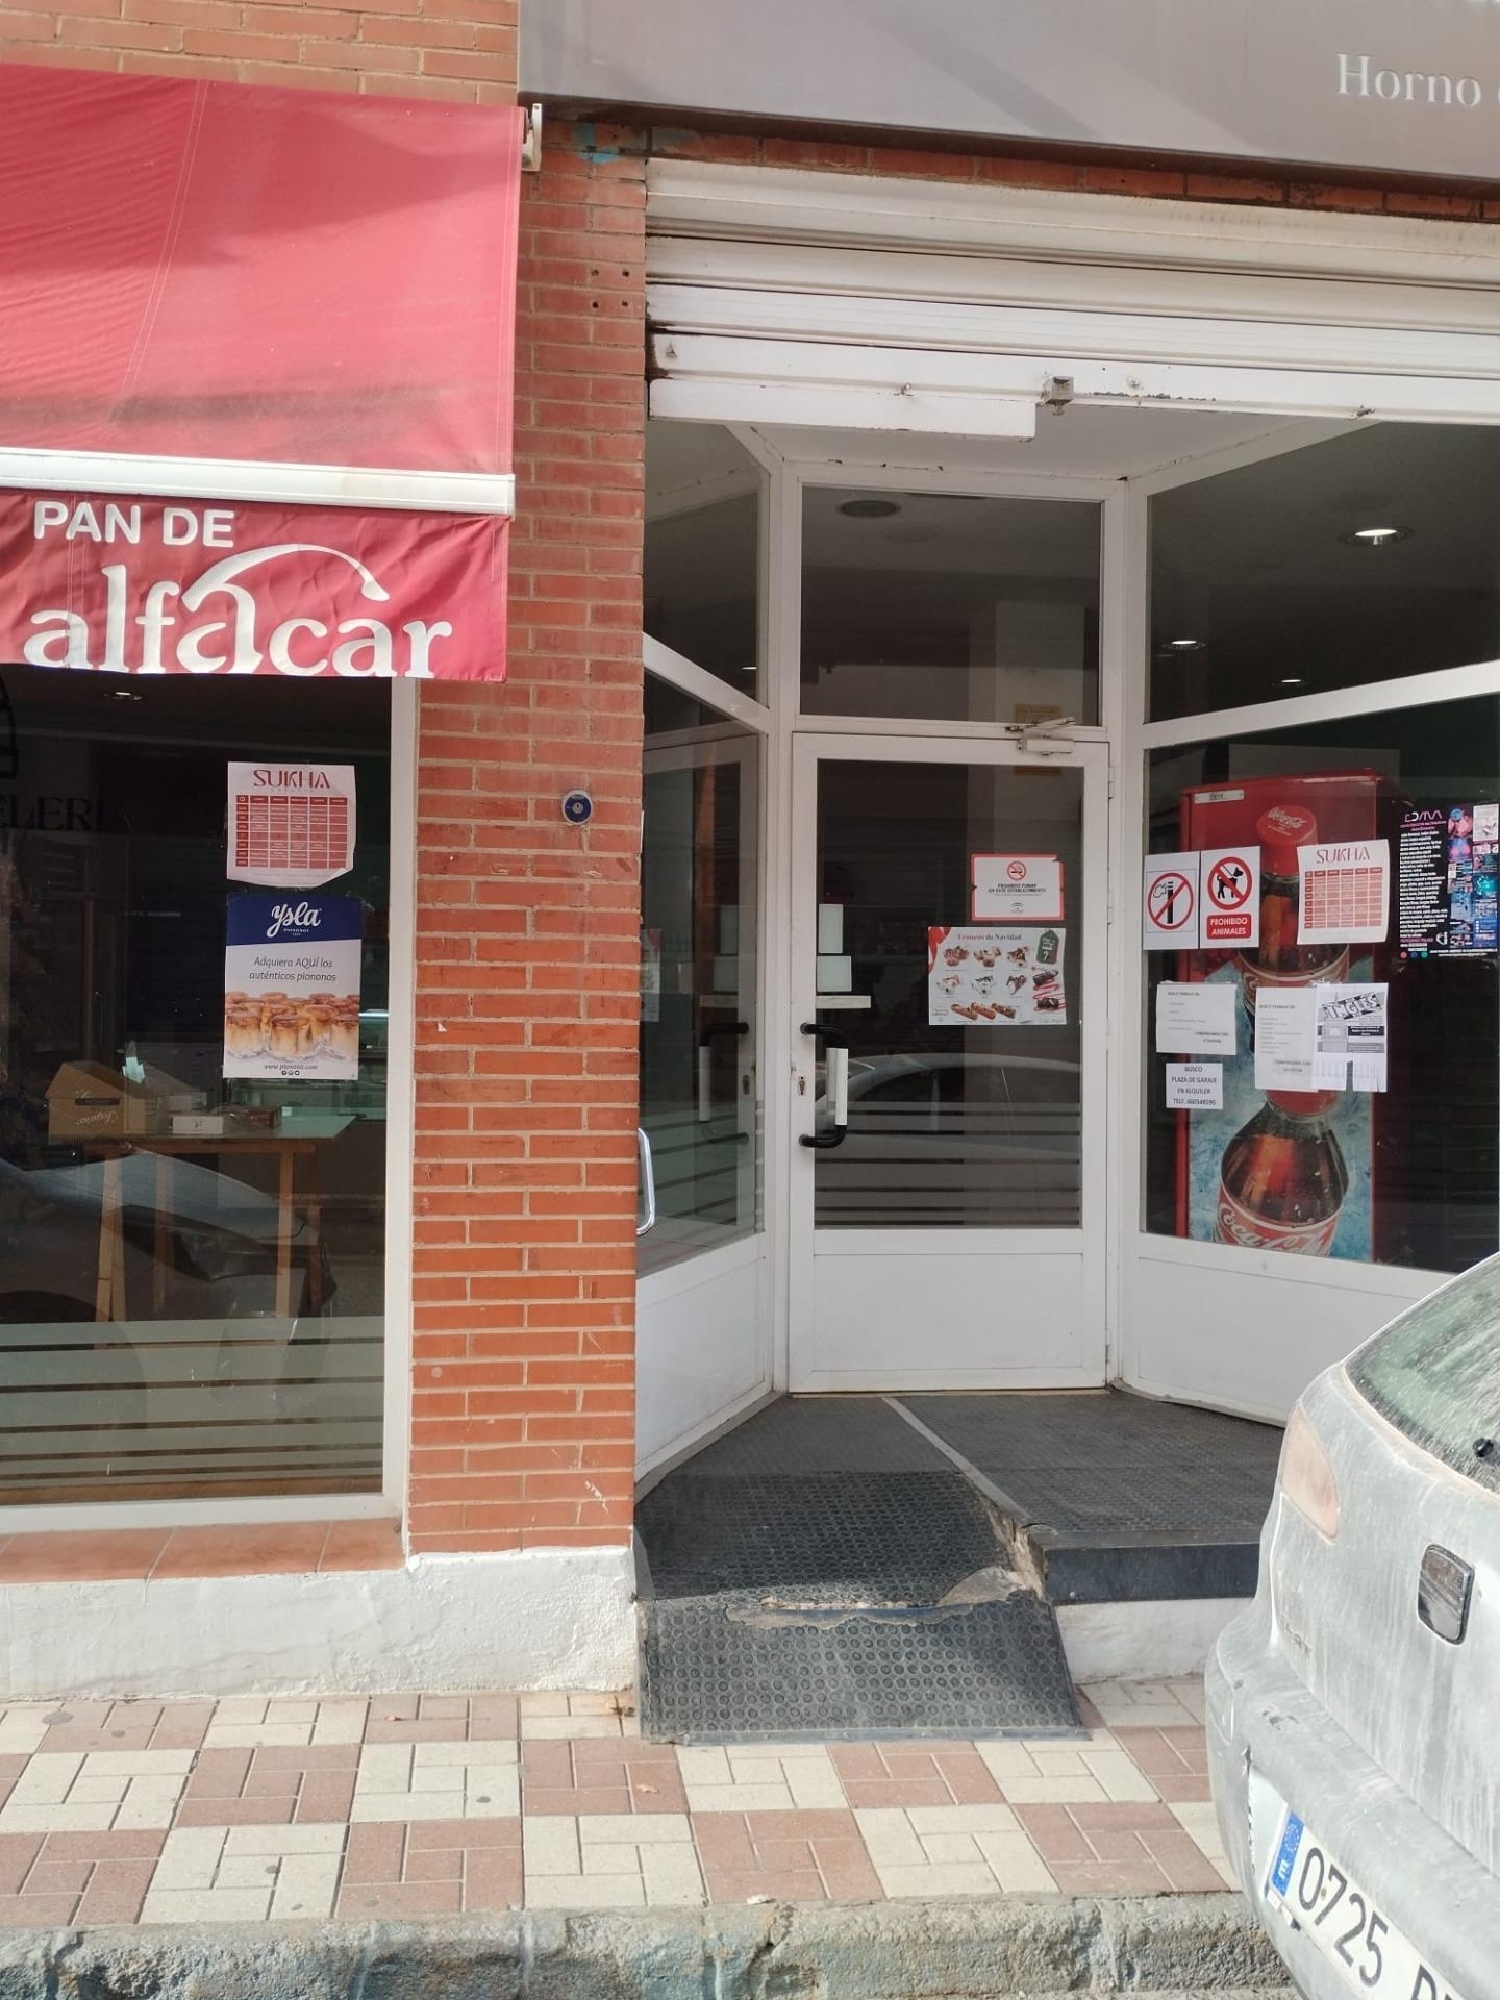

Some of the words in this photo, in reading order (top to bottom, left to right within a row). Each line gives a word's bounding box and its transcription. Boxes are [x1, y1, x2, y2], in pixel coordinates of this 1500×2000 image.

[1335, 52, 1483, 107] Horno
[33, 500, 141, 545] PAN
[163, 506, 235, 548] DE
[23, 543, 453, 678] alfacar
[252, 769, 331, 789] SUKHA
[1316, 846, 1371, 864] SUKHA
[266, 901, 322, 939] ysla
[1209, 917, 1248, 926] PROHIBIDO
[1211, 927, 1247, 936] ANIMALES
[253, 956, 294, 970] Adquiera
[294, 955, 320, 970] AQUÍ
[320, 956, 333, 968] los
[249, 970, 295, 981] auténticos
[296, 972, 337, 983] piononos
[1327, 992, 1378, 1019] INGLÉS
[1171, 1075, 1187, 1083] PLAZA
[1196, 1076, 1218, 1084] GARAJE
[1277, 1857, 1290, 1880] E
[1298, 1846, 1389, 1988] 0725
